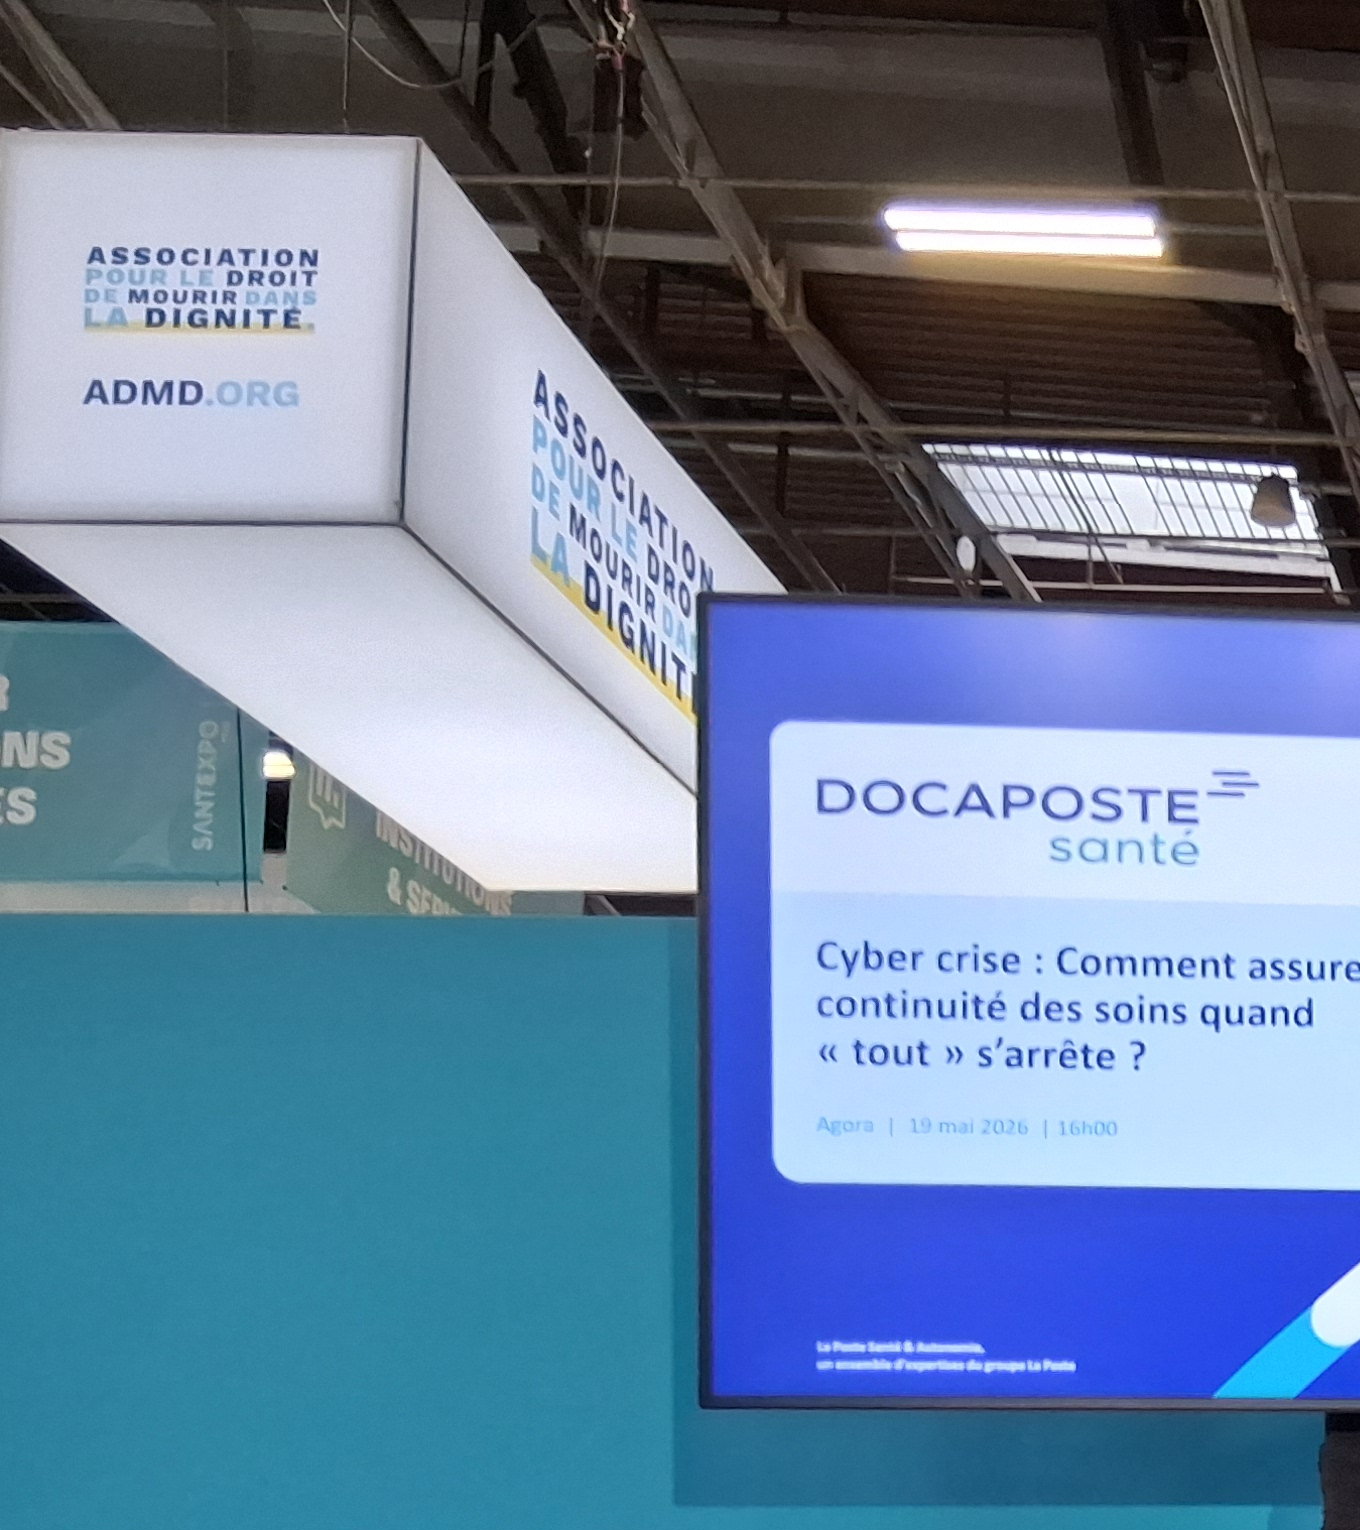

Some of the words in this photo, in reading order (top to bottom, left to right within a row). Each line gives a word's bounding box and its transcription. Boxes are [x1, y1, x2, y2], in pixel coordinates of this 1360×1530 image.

[87, 246, 319, 267] ASSOCIATION
[86, 268, 168, 286] POUR
[180, 269, 214, 286] LE
[227, 270, 318, 287] DROIT
[84, 288, 118, 303] DE
[128, 289, 237, 305] MOURIR
[246, 291, 317, 306] DANS
[84, 307, 128, 328] LA
[83, 379, 300, 407] ADMD.ORG
[533, 368, 714, 592] ASSOCIATION
[532, 413, 601, 522] POUR
[610, 501, 638, 564] LE
[647, 542, 692, 619] DRO
[531, 461, 561, 521] DE
[568, 502, 657, 624] MOURIR
[531, 505, 570, 588] LA
[816, 778, 1200, 825] DOCAPOSTE
[1049, 829, 1200, 866] santé
[817, 940, 924, 978] Cyber
[937, 943, 1021, 974] crise
[1056, 946, 1236, 979] Comment
[817, 989, 1007, 1021] continuité
[1020, 991, 1082, 1022] des
[1095, 994, 1188, 1025] soins
[1200, 997, 1314, 1033] quand
[853, 1039, 929, 1067] tout
[816, 1116, 874, 1137] Agora
[910, 1117, 932, 1134] 19
[939, 1117, 974, 1134] mai
[981, 1119, 1029, 1136] 2026
[1059, 1119, 1118, 1137] 16h00
